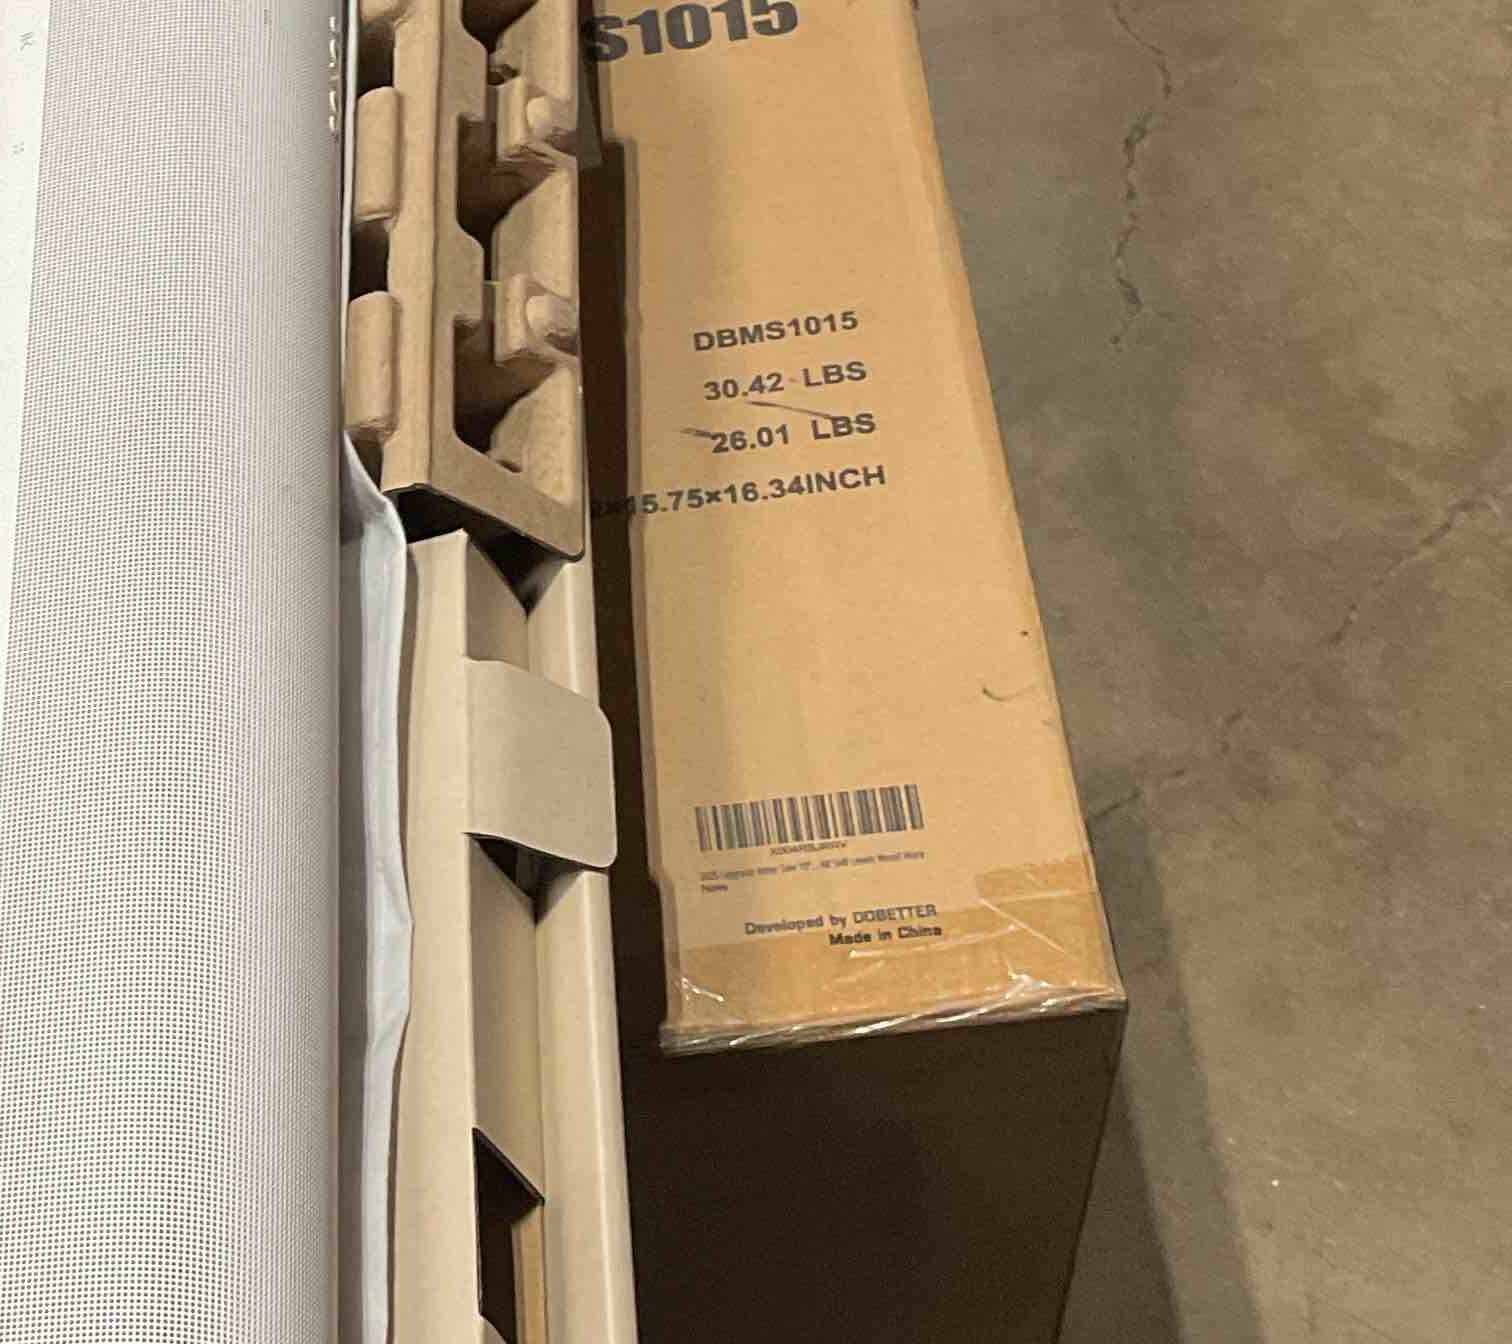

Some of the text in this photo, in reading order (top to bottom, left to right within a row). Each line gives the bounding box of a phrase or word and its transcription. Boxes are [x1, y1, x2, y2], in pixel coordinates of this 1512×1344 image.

[692, 309, 859, 352] DBMS1015
[703, 360, 868, 402] 30.42 LBS
[710, 412, 877, 454] 26.01 LBS
[744, 915, 824, 935] Developed
[829, 913, 847, 929] by
[829, 925, 942, 946] Made in China
